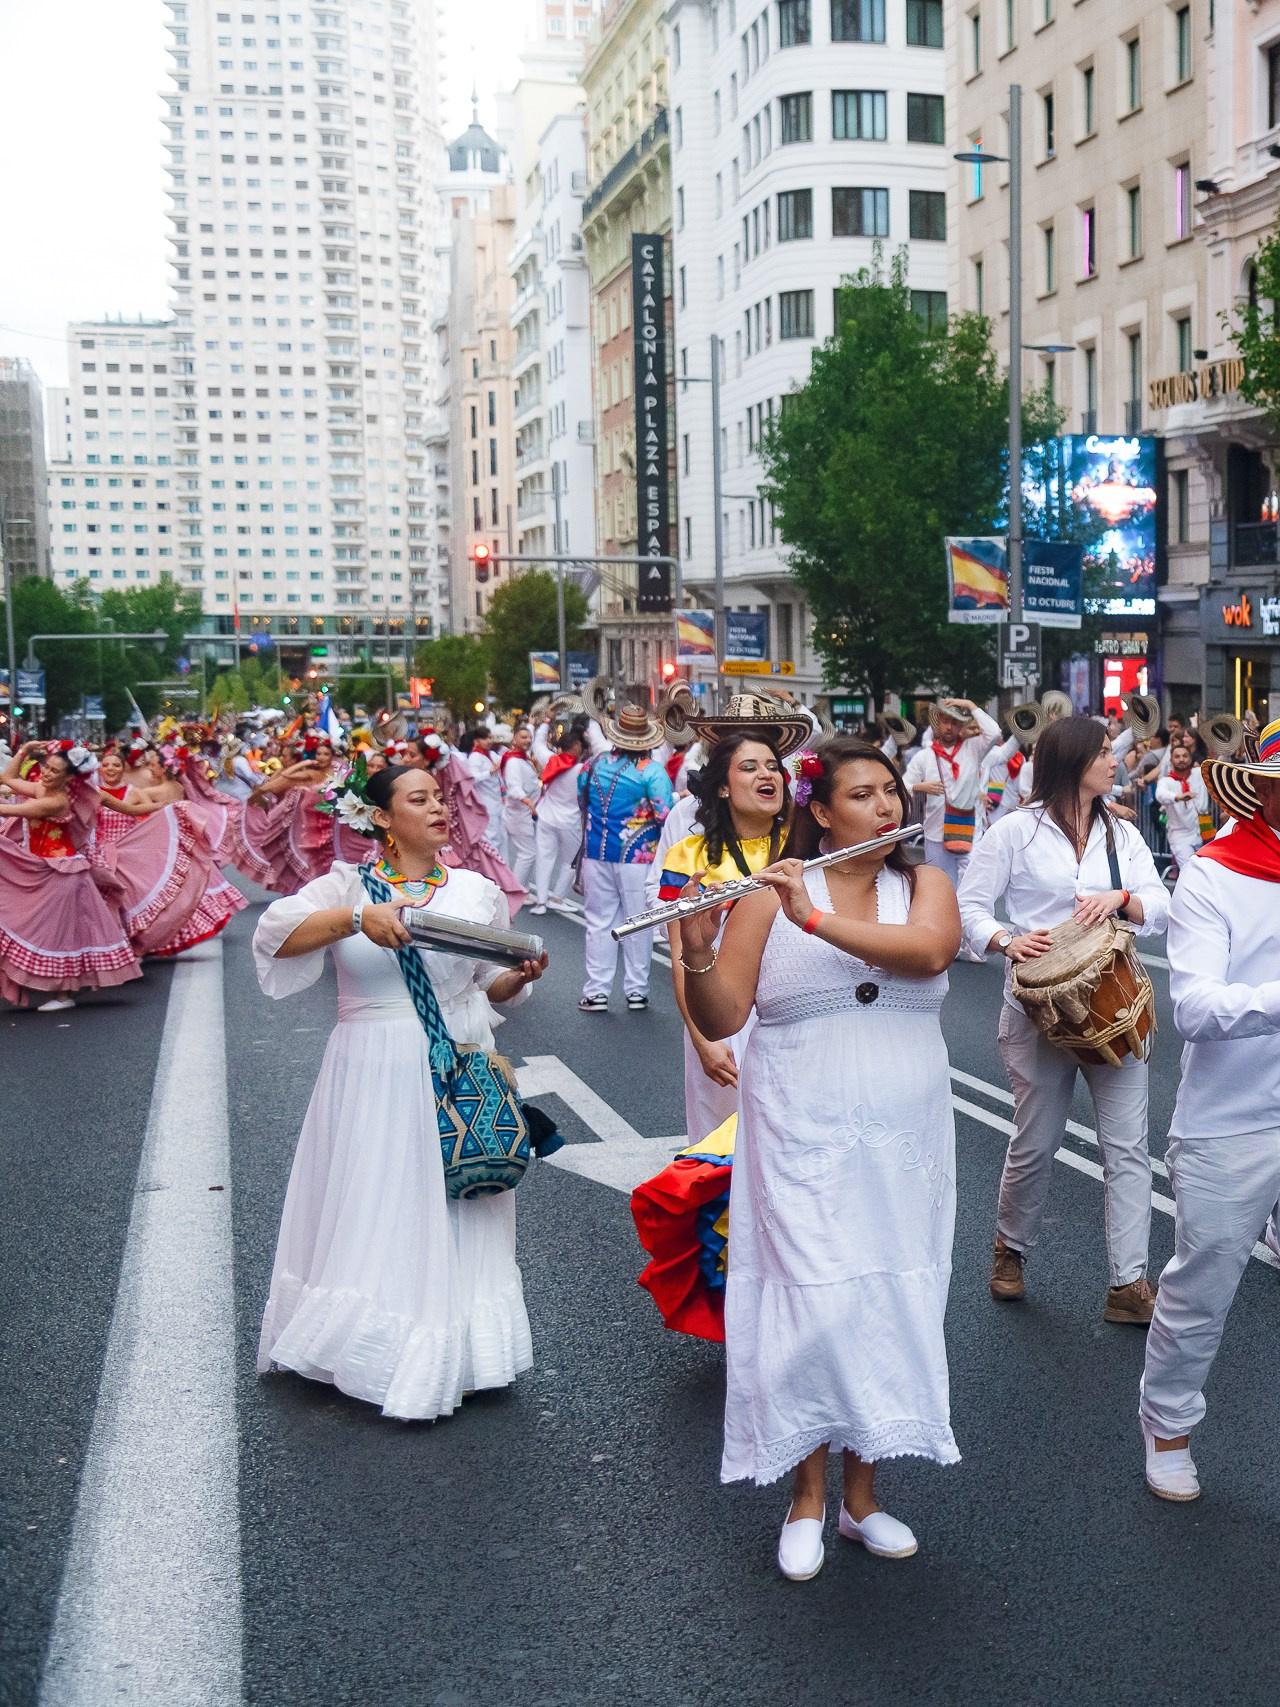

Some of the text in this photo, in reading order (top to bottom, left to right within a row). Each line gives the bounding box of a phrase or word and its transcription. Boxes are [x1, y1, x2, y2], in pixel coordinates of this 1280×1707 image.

[641, 244, 661, 579] CATALONIA PLAZA ESPAÑA
[1028, 565, 1055, 576] FIESTA
[1028, 576, 1070, 588] NACIONAL
[1028, 596, 1037, 607] 12
[1038, 597, 1076, 611] OCTUBRE
[1222, 594, 1251, 627] wok
[1010, 624, 1030, 652] P
